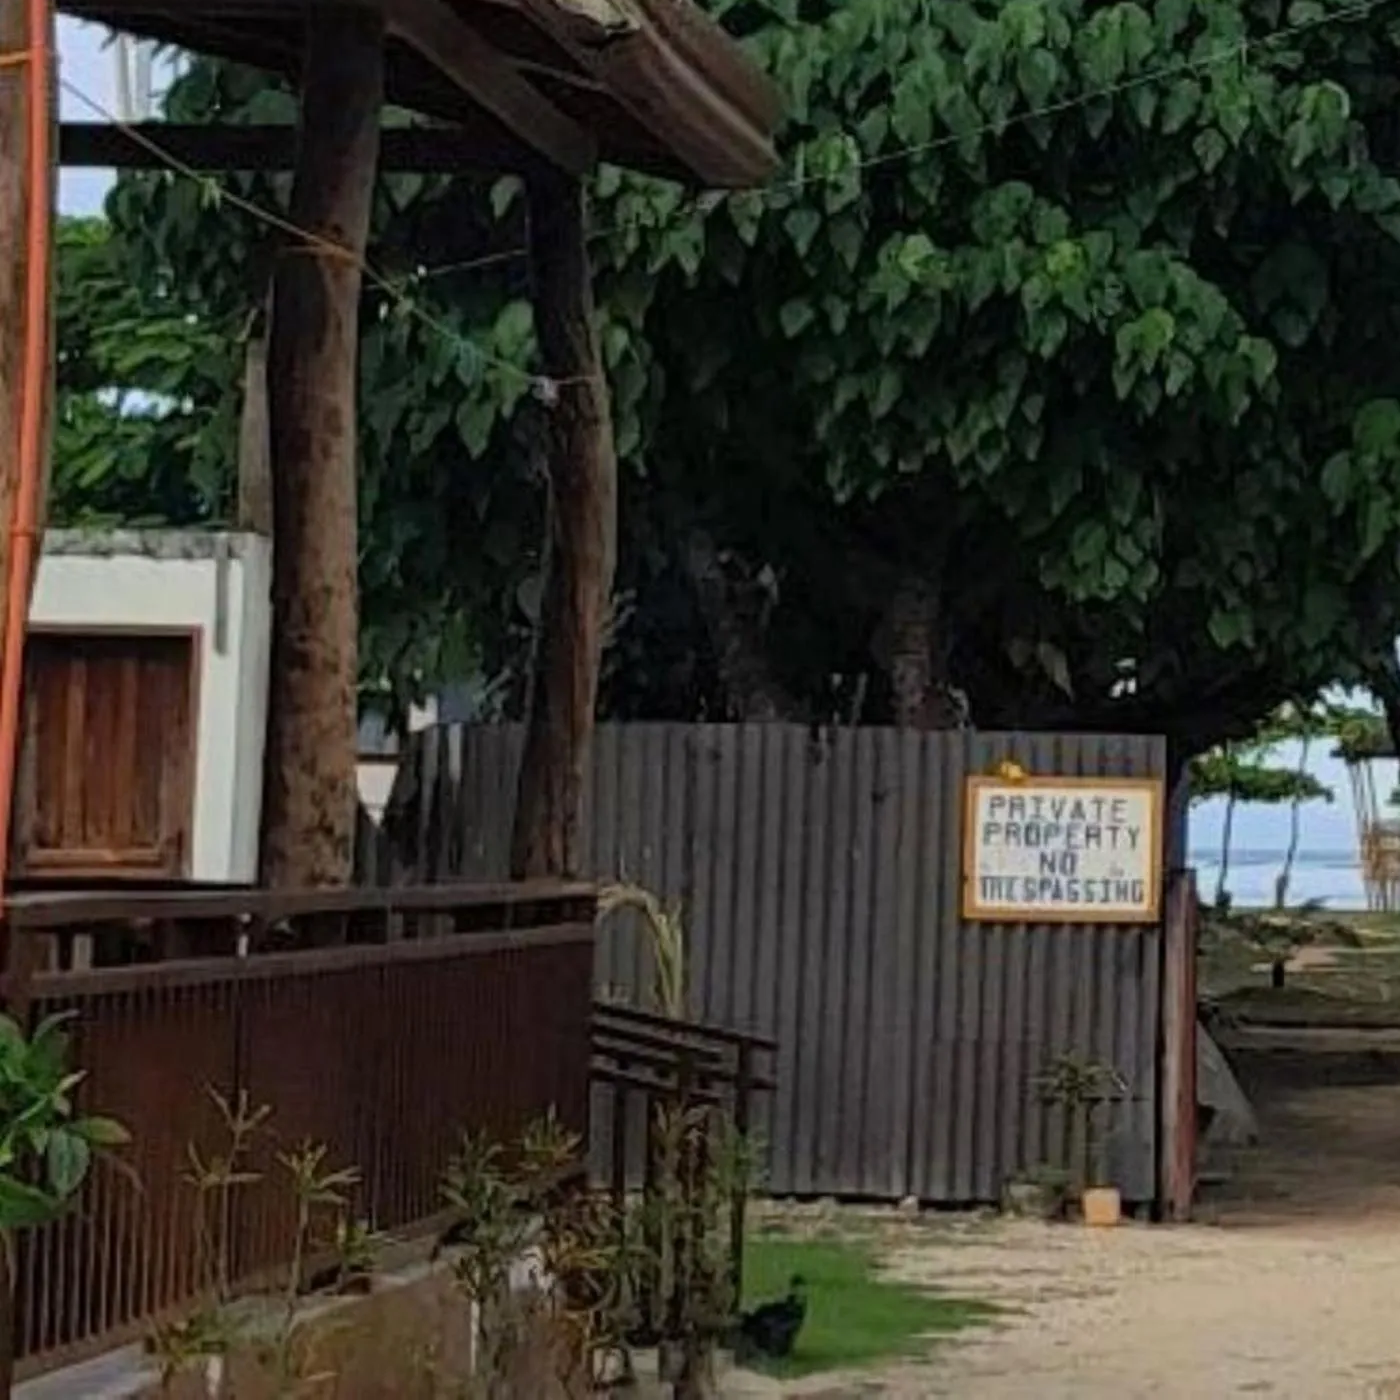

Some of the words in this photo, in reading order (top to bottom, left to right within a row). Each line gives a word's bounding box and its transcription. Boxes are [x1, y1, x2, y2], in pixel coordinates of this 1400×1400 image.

[988, 794, 1128, 824] PRIVATE
[982, 821, 1141, 850] PROPERTY
[1039, 850, 1079, 877] NO
